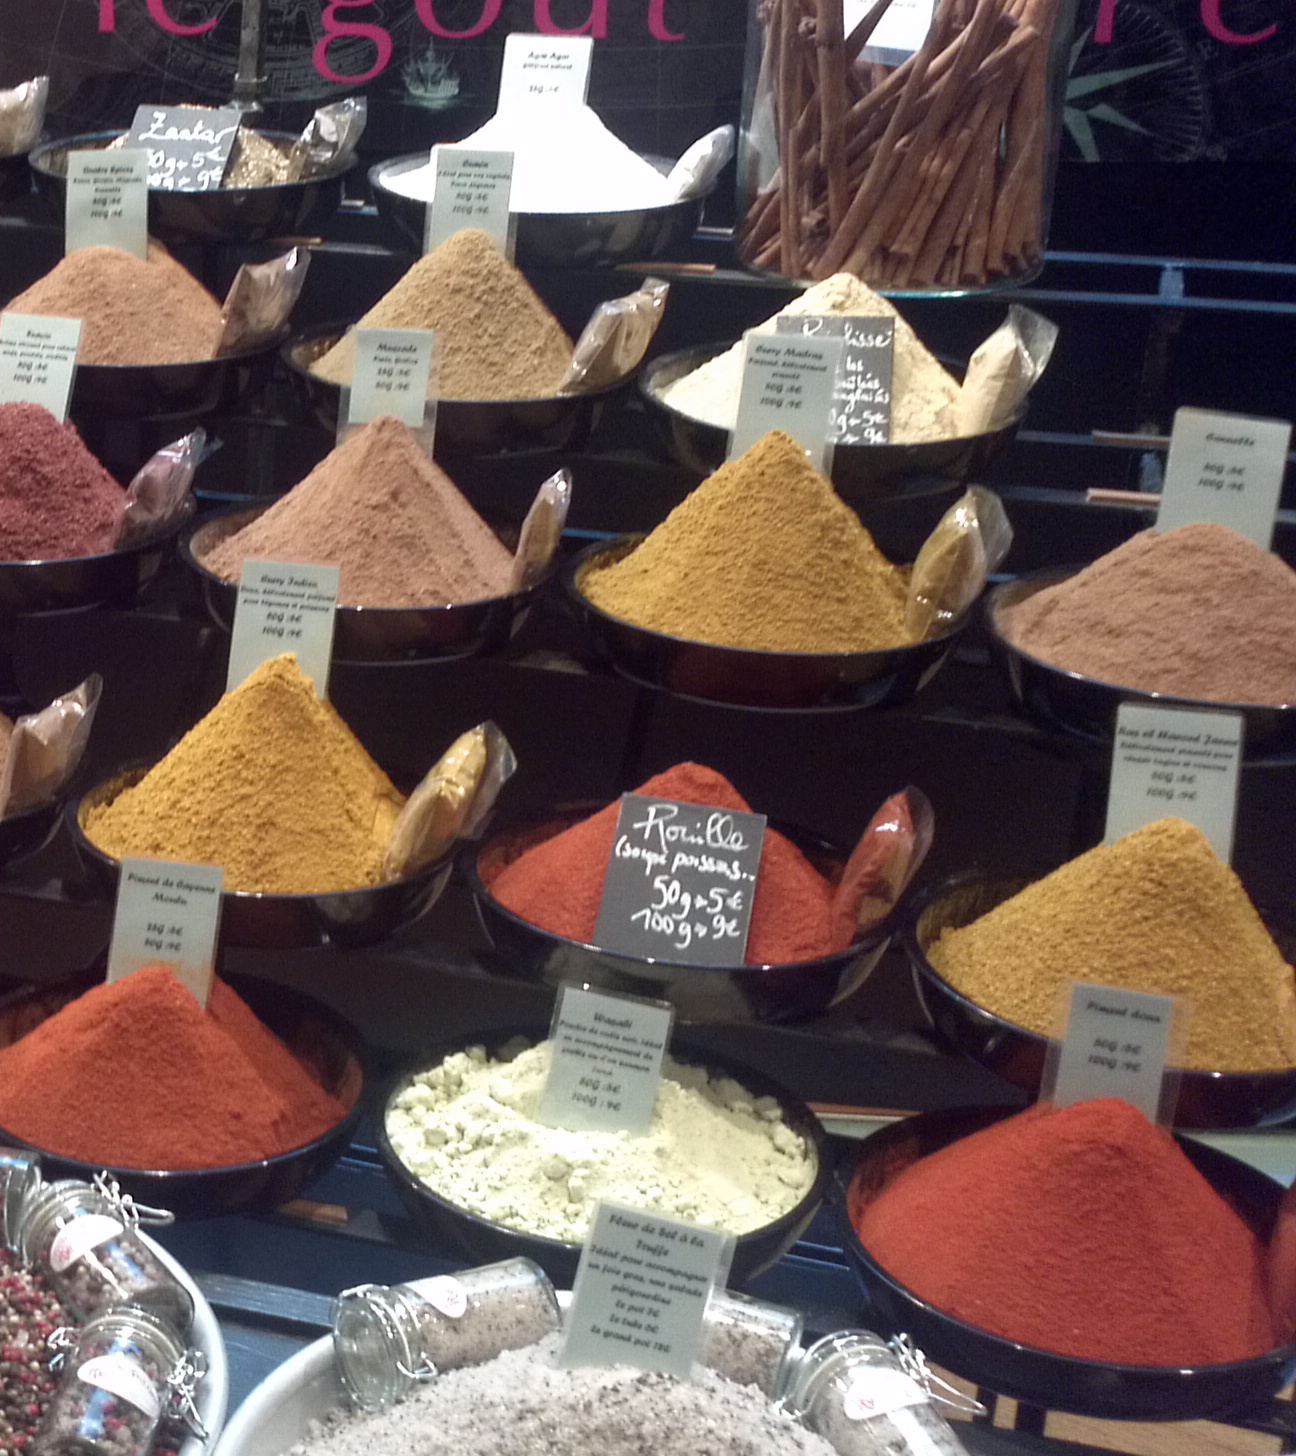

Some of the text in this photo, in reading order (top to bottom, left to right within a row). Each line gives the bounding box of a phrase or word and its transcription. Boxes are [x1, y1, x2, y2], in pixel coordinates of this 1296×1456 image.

[783, 347, 823, 361] Madras
[633, 803, 750, 854] Rouille
[127, 872, 159, 886] Piment
[162, 877, 174, 887] de
[651, 874, 744, 920] 50g 5€
[630, 909, 692, 950] 100g
[657, 1225, 678, 1241] Sel
[625, 1303, 645, 1314] pot
